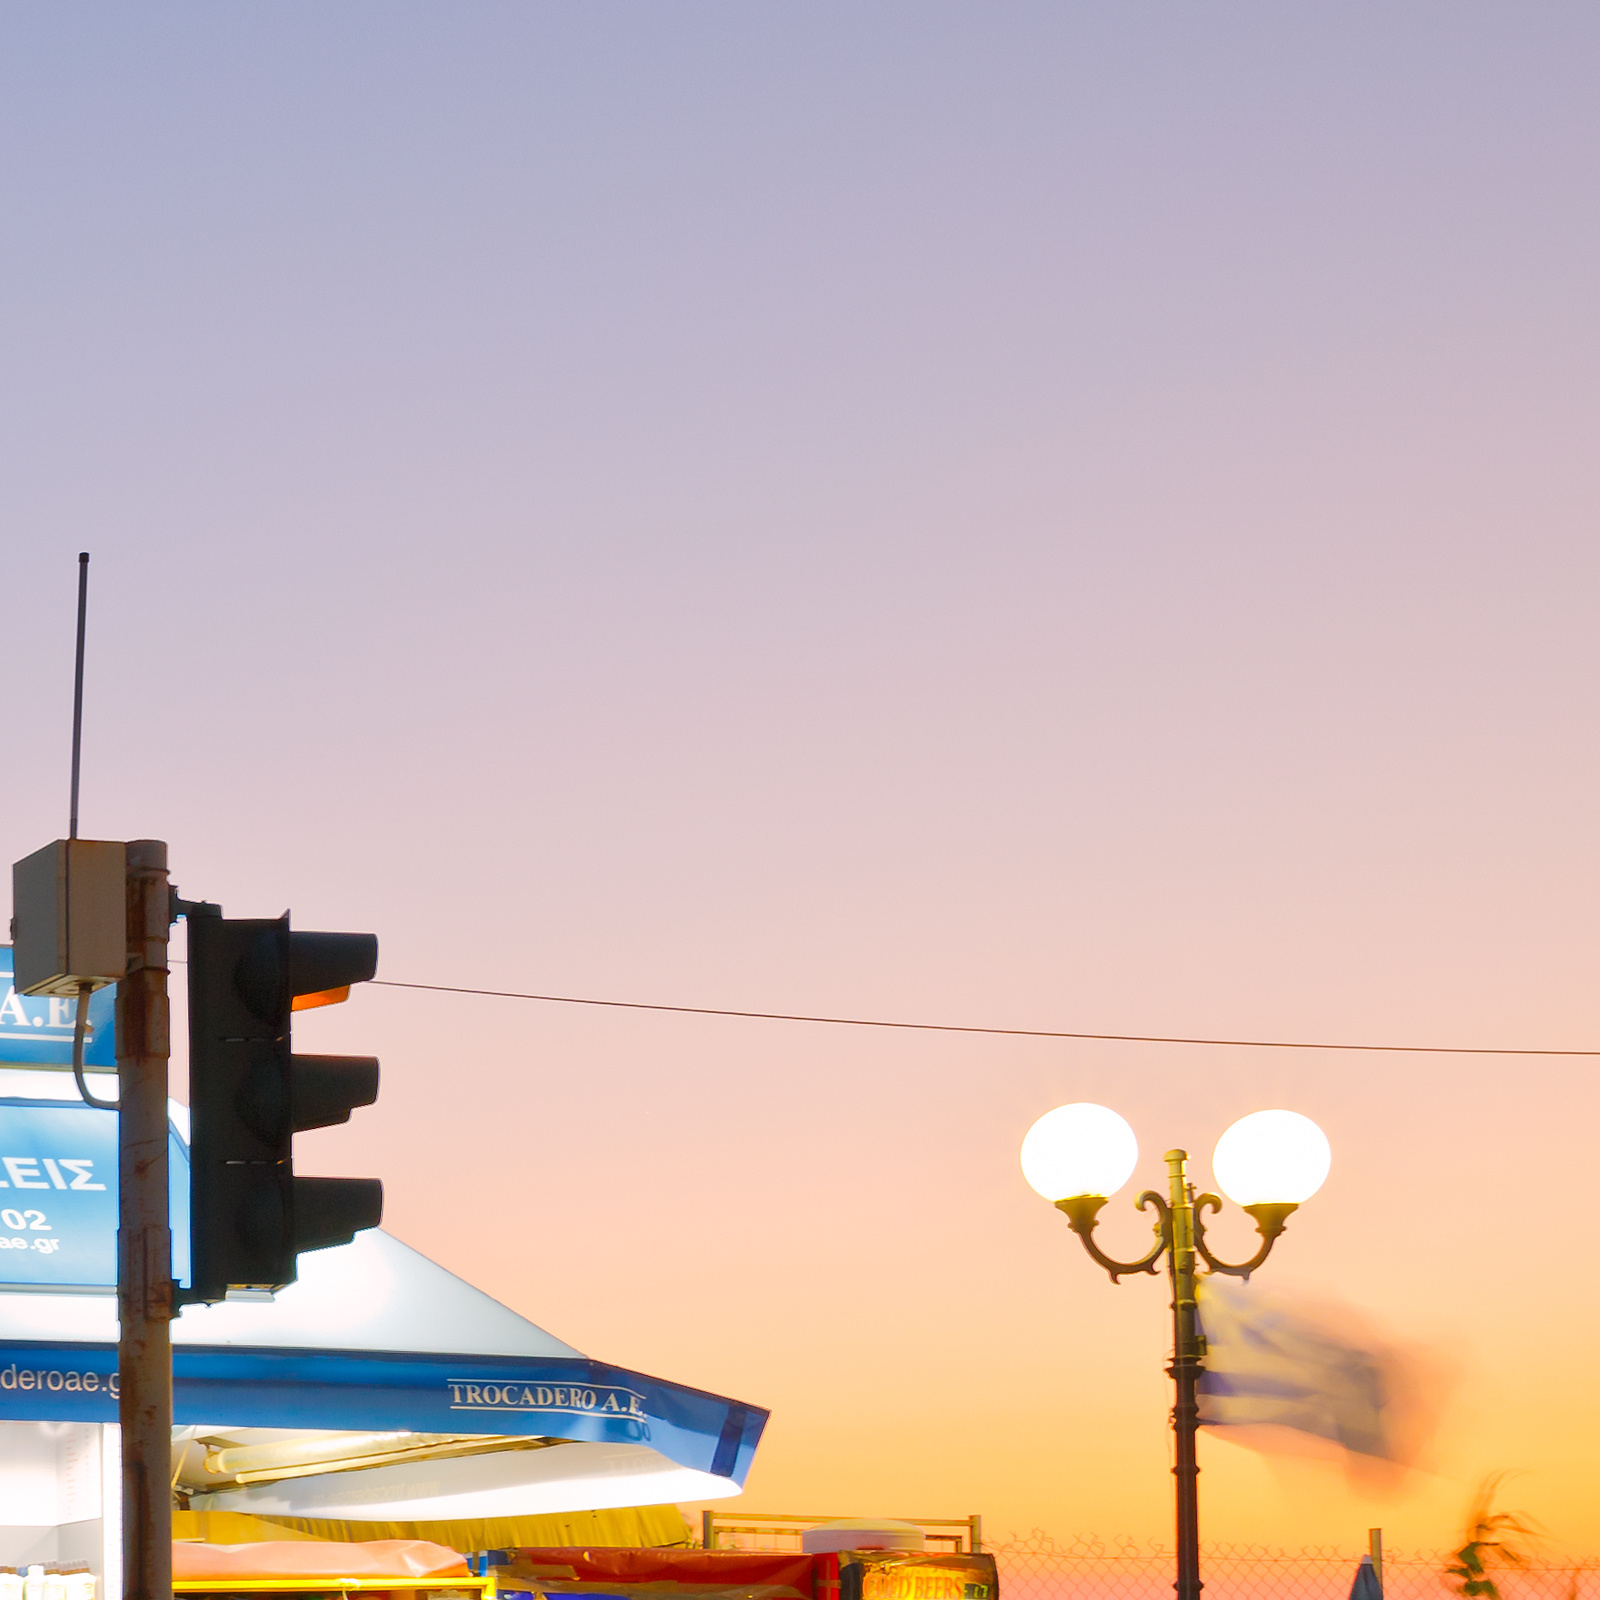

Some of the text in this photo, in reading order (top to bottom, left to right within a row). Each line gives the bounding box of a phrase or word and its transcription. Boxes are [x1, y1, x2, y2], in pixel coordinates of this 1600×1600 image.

[447, 1383, 648, 1418] TROCADERO A.E.
[914, 1576, 963, 1600] BEERS
